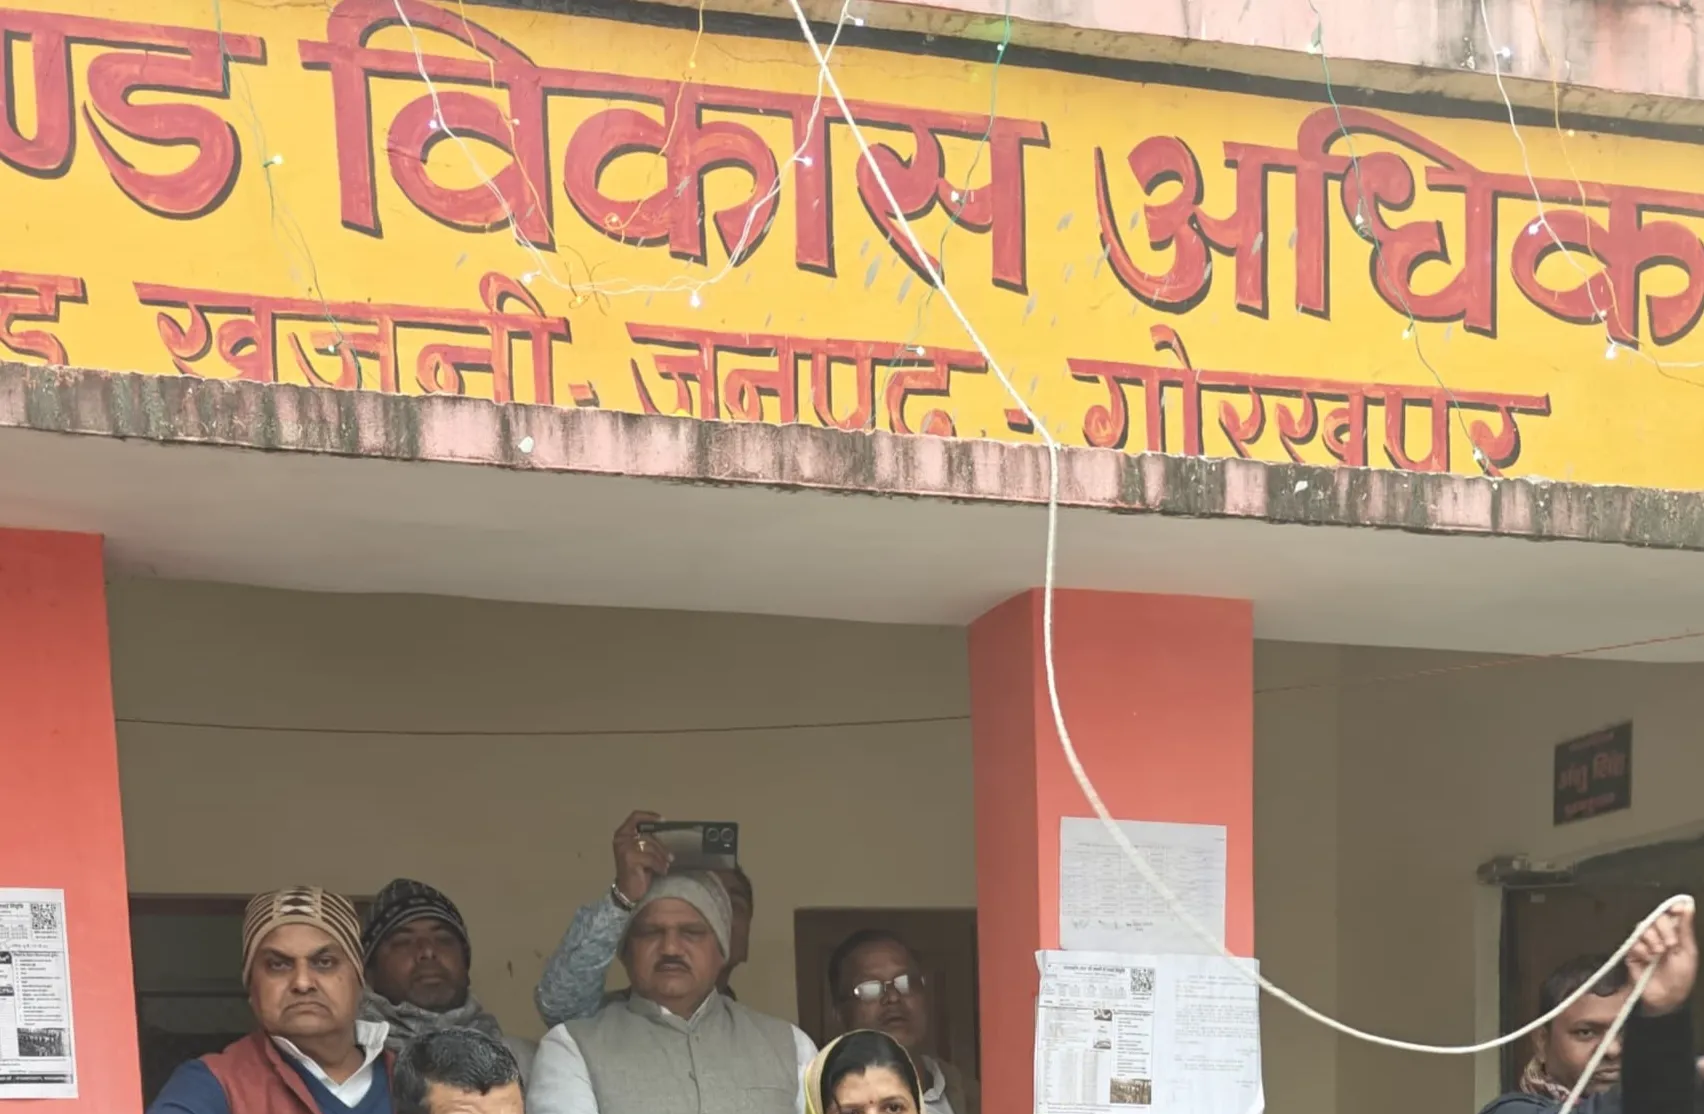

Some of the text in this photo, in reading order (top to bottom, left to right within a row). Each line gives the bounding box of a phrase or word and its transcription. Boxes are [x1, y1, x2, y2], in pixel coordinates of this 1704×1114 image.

[298, 0, 1050, 295] विकास
[1094, 106, 1704, 350] अधिक
[1067, 324, 1551, 477] गोरखपर
